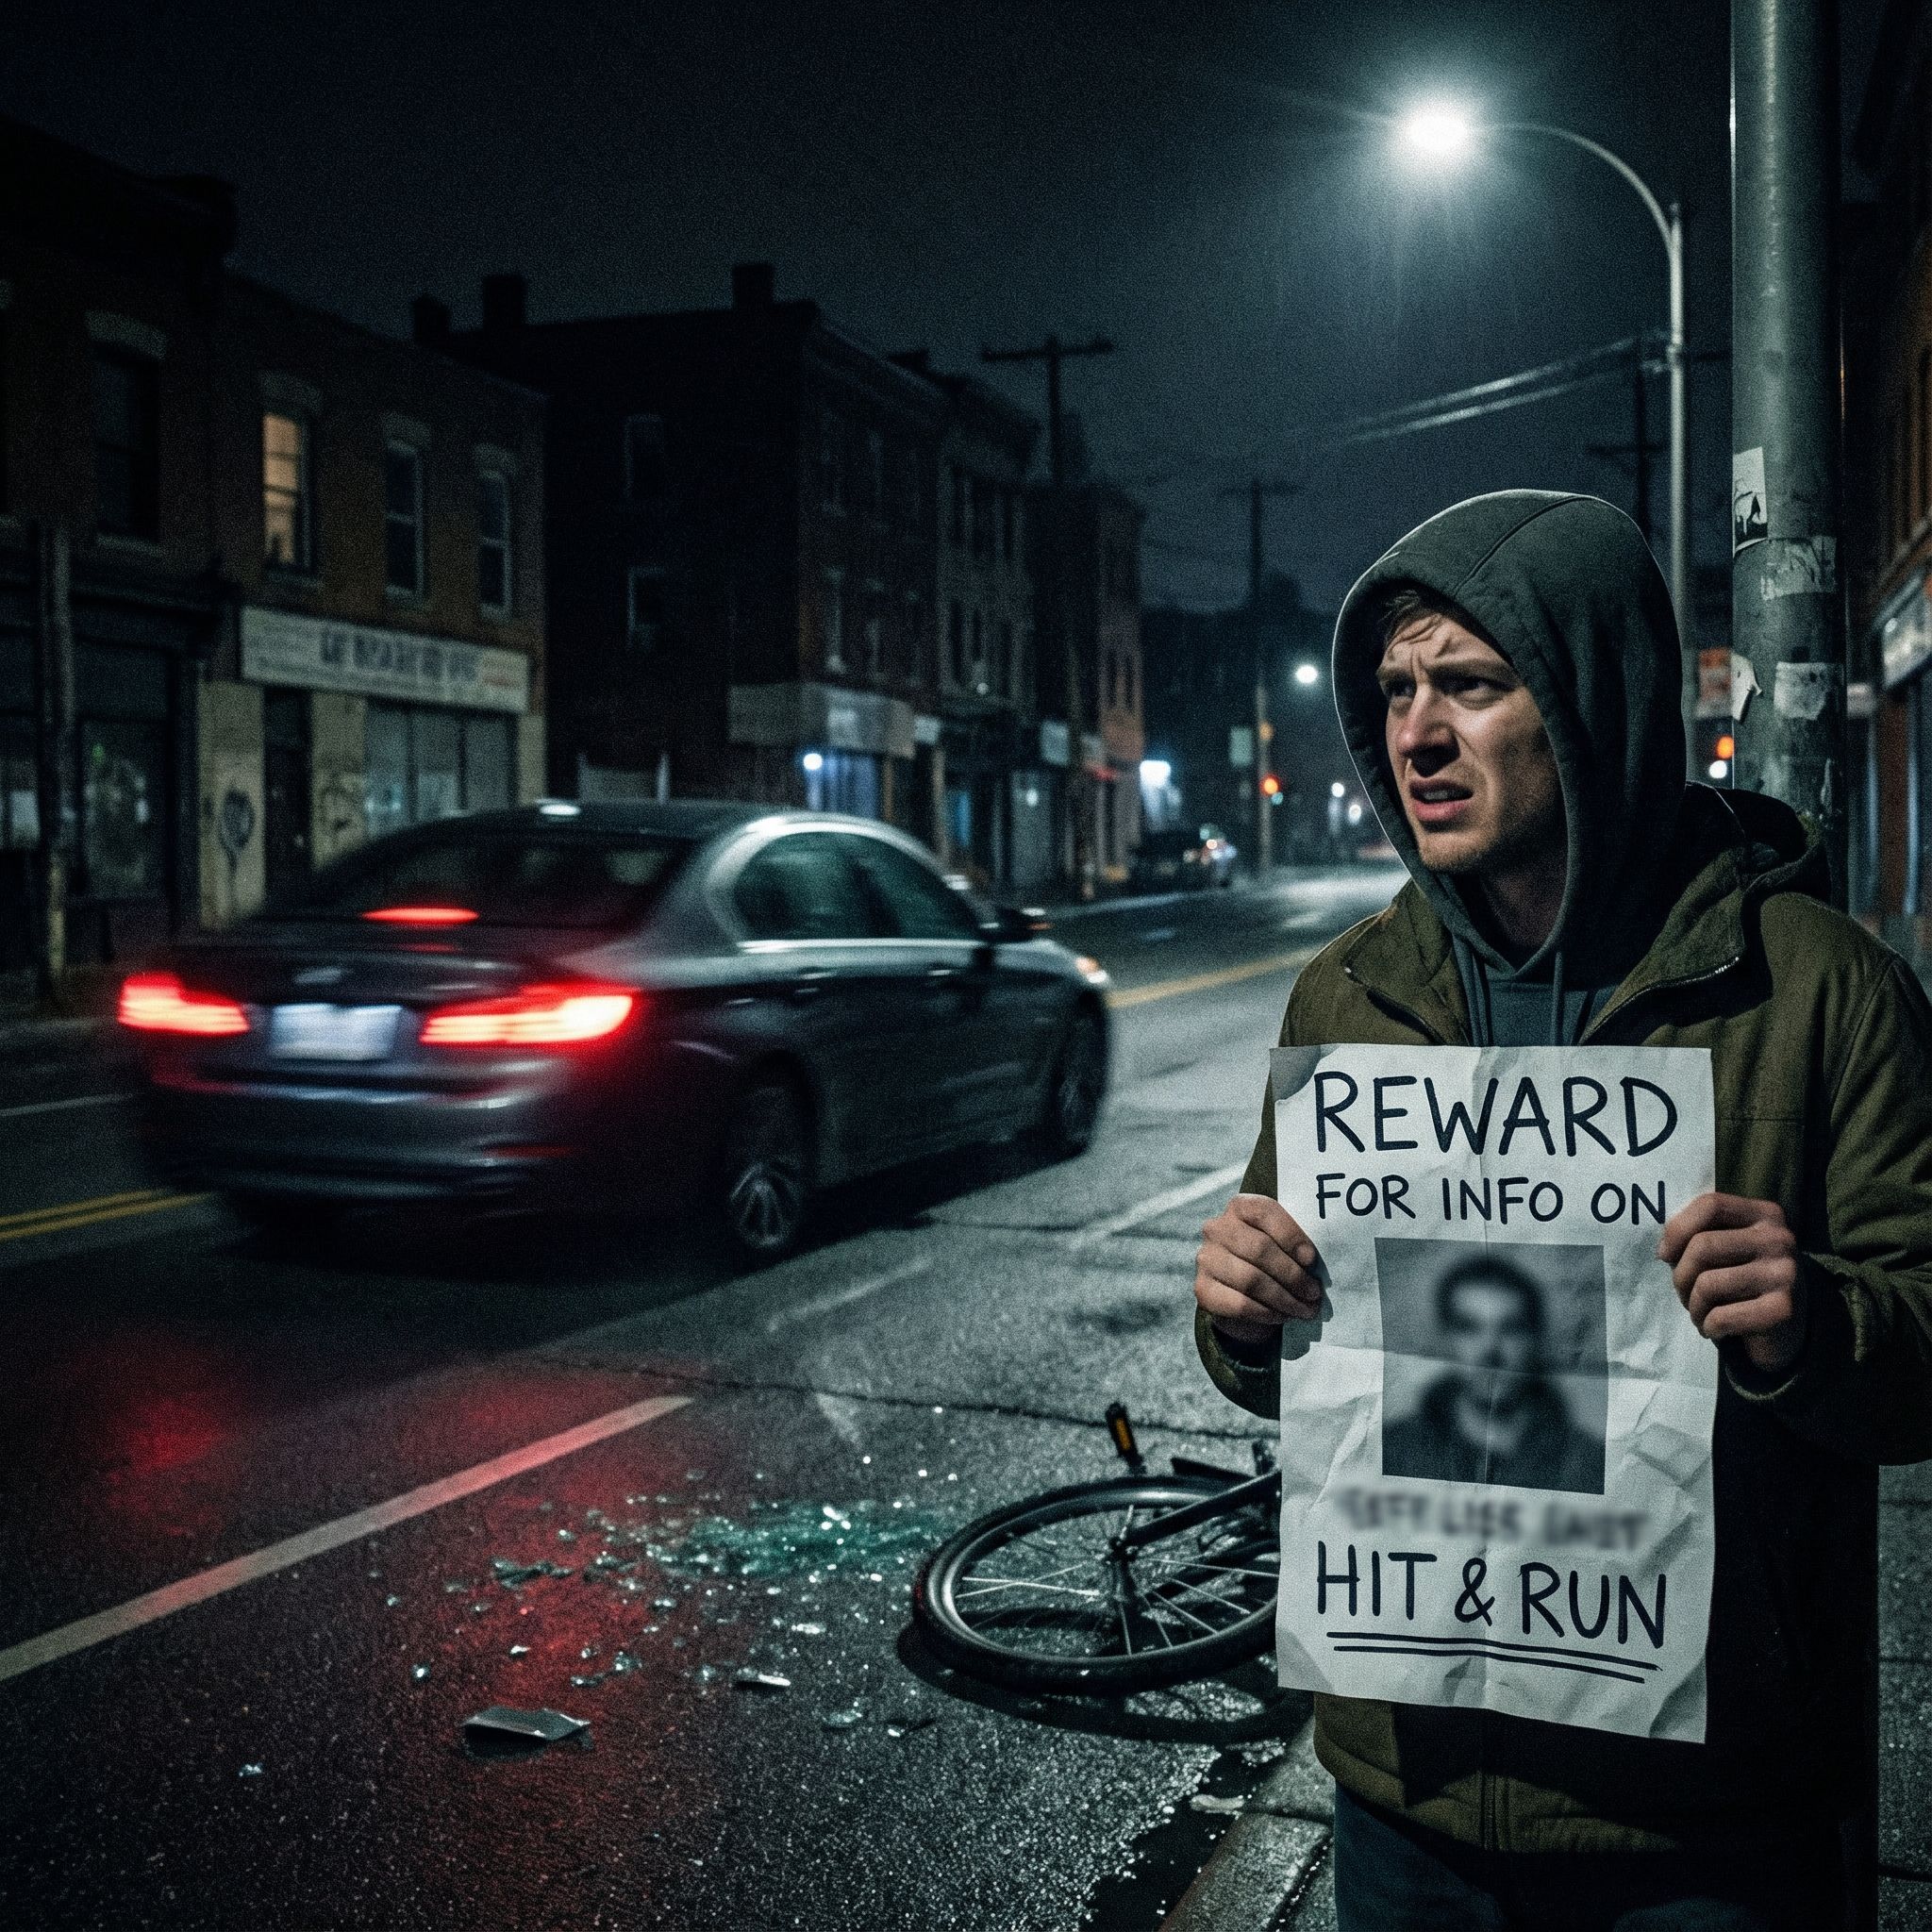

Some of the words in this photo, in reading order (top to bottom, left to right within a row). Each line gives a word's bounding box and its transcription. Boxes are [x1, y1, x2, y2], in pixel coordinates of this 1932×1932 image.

[1314, 1072, 1678, 1158] REWARD
[1316, 1173, 1416, 1219] FOR
[1442, 1176, 1564, 1225] INFO
[1591, 1180, 1666, 1225] ON
[1317, 1541, 1437, 1621] HIT
[1454, 1557, 1495, 1626] &
[1518, 1561, 1667, 1649] RUN
